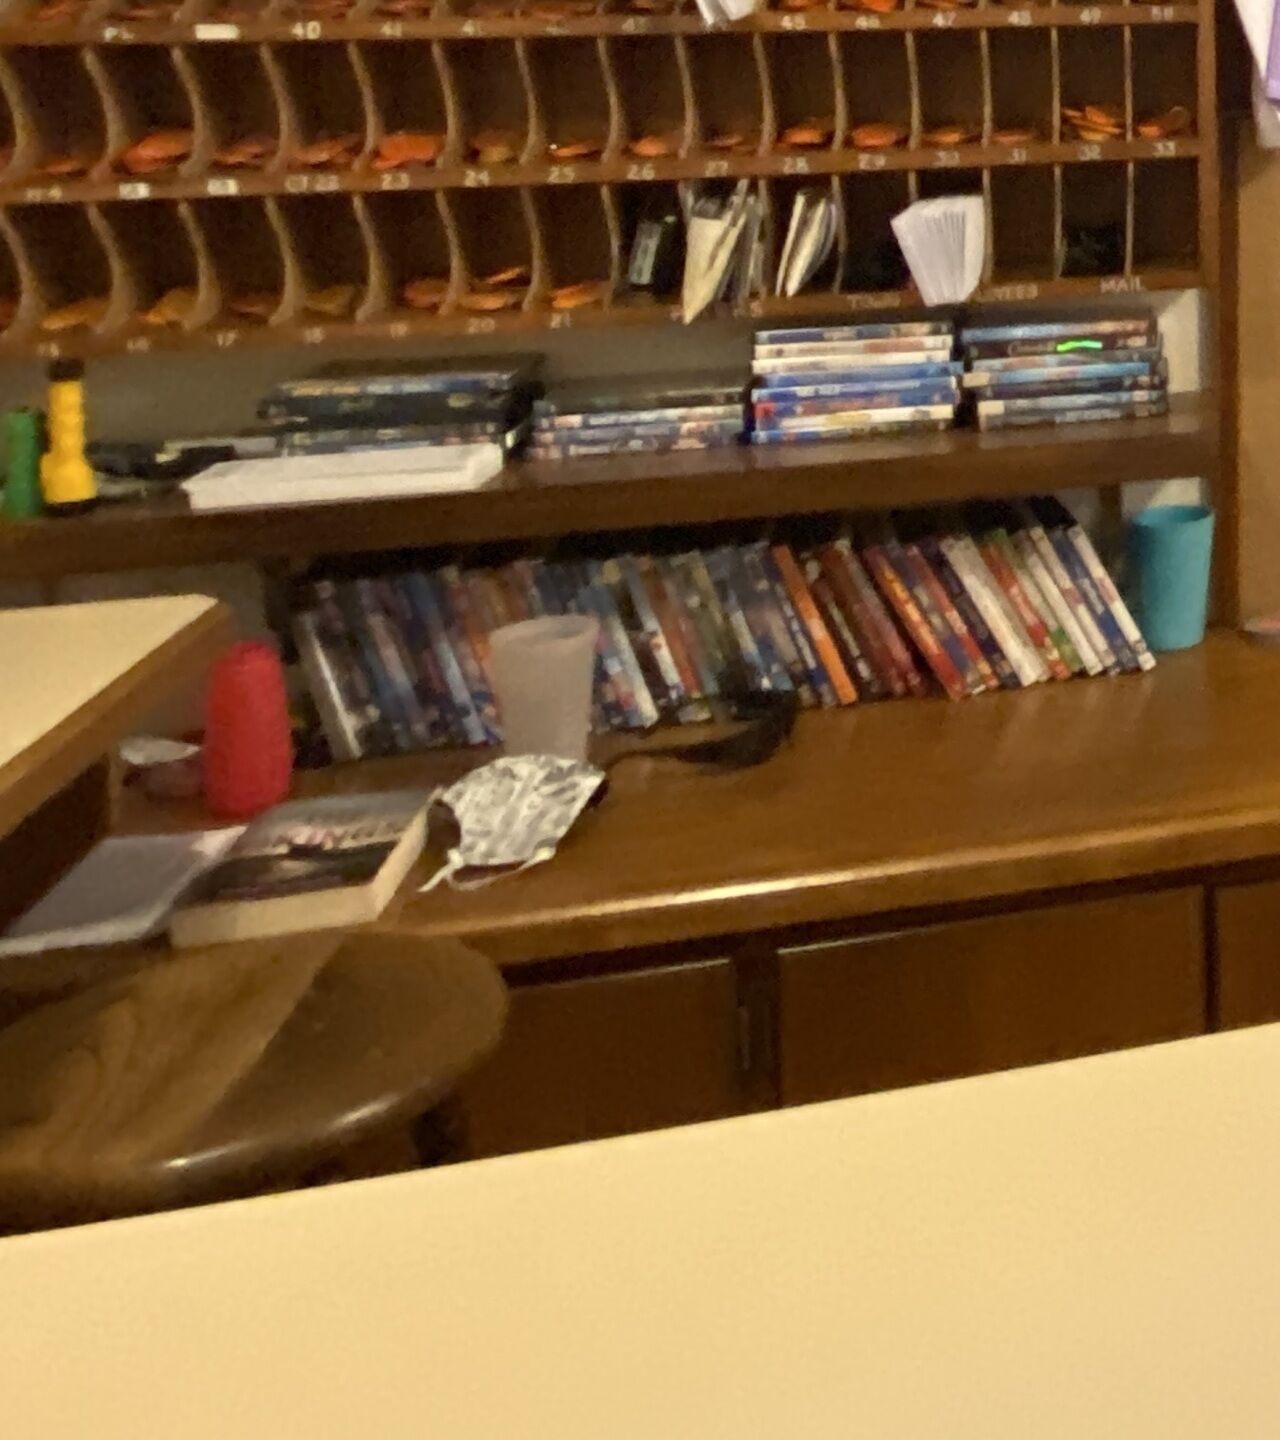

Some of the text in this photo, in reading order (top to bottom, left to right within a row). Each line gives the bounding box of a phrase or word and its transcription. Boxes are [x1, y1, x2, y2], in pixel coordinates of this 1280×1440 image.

[465, 170, 489, 187] 24
[548, 166, 575, 184] 25
[626, 164, 654, 181] 26
[1101, 277, 1146, 292] MAIL
[468, 317, 495, 333] 20
